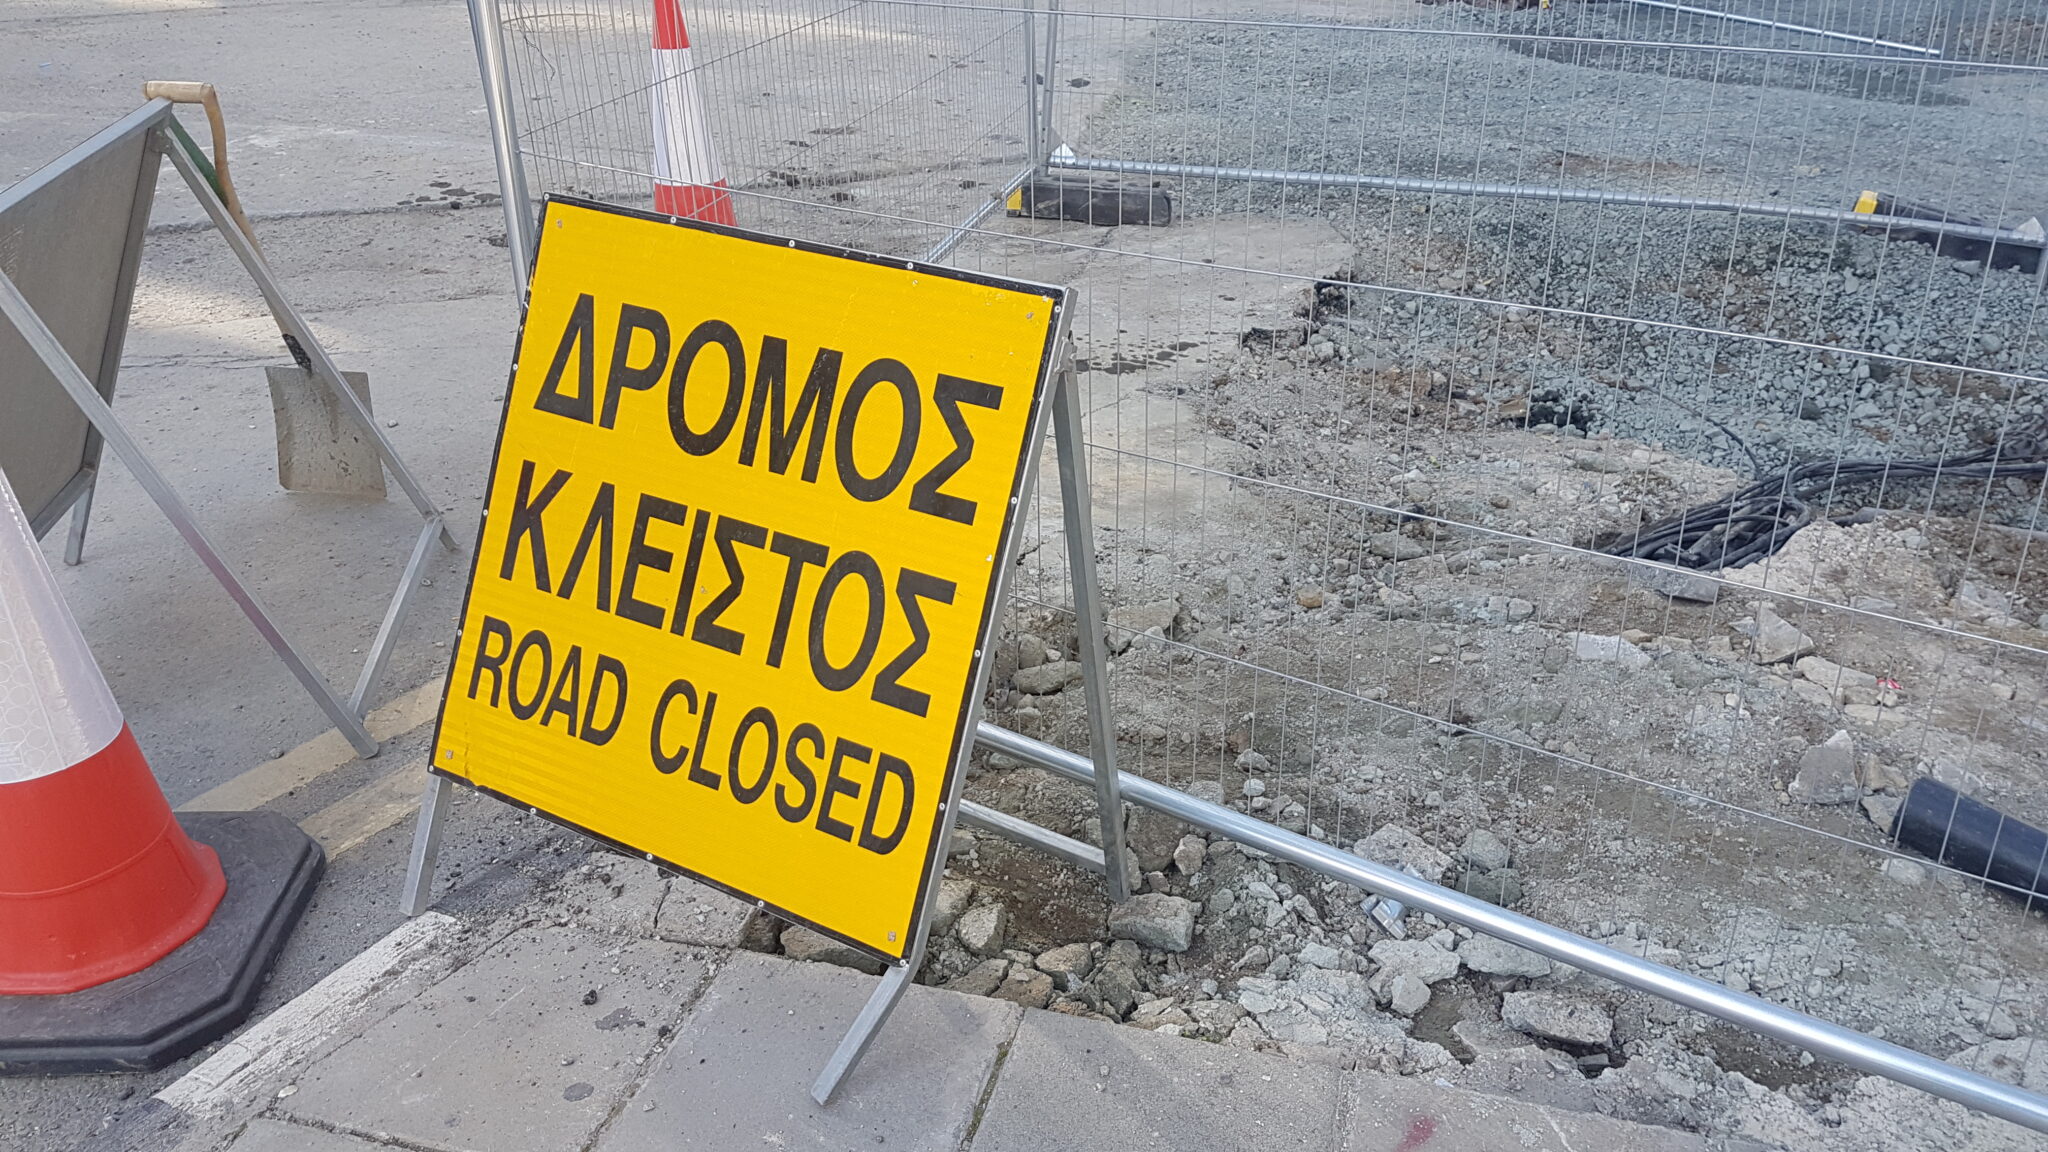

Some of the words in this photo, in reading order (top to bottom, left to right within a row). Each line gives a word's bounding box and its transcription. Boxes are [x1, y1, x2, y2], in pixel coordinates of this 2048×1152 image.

[534, 294, 1004, 526] ΔΡΟΜΟΣ
[500, 461, 957, 718] ΚΛΕΙΣΤΟΣ
[468, 616, 628, 746] ROAD
[650, 679, 915, 855] CLOSED
